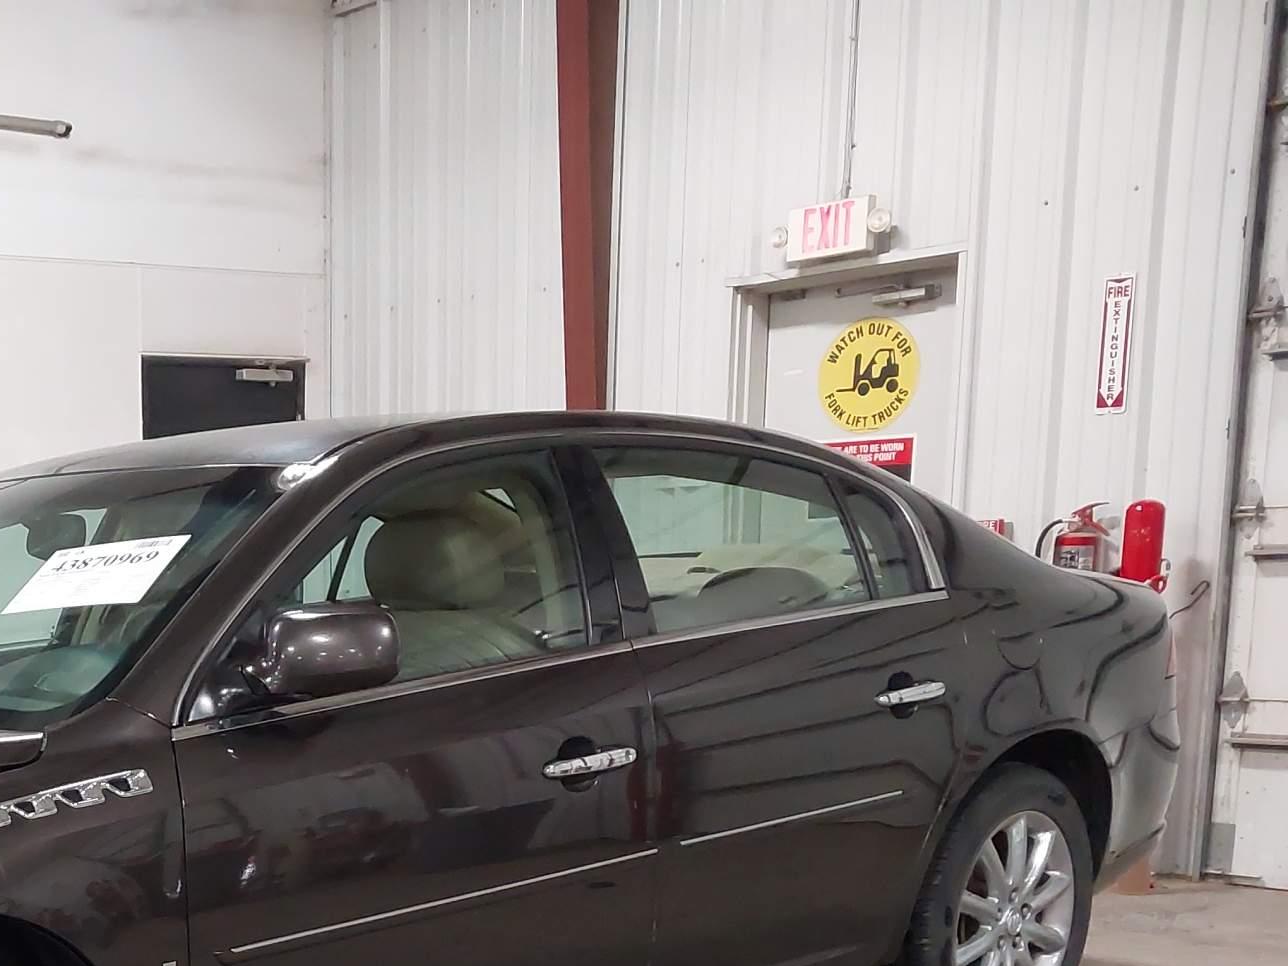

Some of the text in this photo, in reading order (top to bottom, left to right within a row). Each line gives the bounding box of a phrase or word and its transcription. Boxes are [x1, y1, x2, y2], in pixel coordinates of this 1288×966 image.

[802, 200, 856, 254] EXIT
[1107, 285, 1130, 299] FIRE
[827, 322, 913, 365] WATCH OUT FOR
[1106, 300, 1122, 401] EXTINGUISHER
[824, 387, 909, 428] FORK LIFT TRUCKS
[843, 445, 858, 454] ARE
[859, 444, 869, 453] TO
[869, 443, 880, 452] BE
[880, 442, 905, 452] WORN
[873, 452, 897, 462] POINT
[51, 550, 160, 572] 43870969
